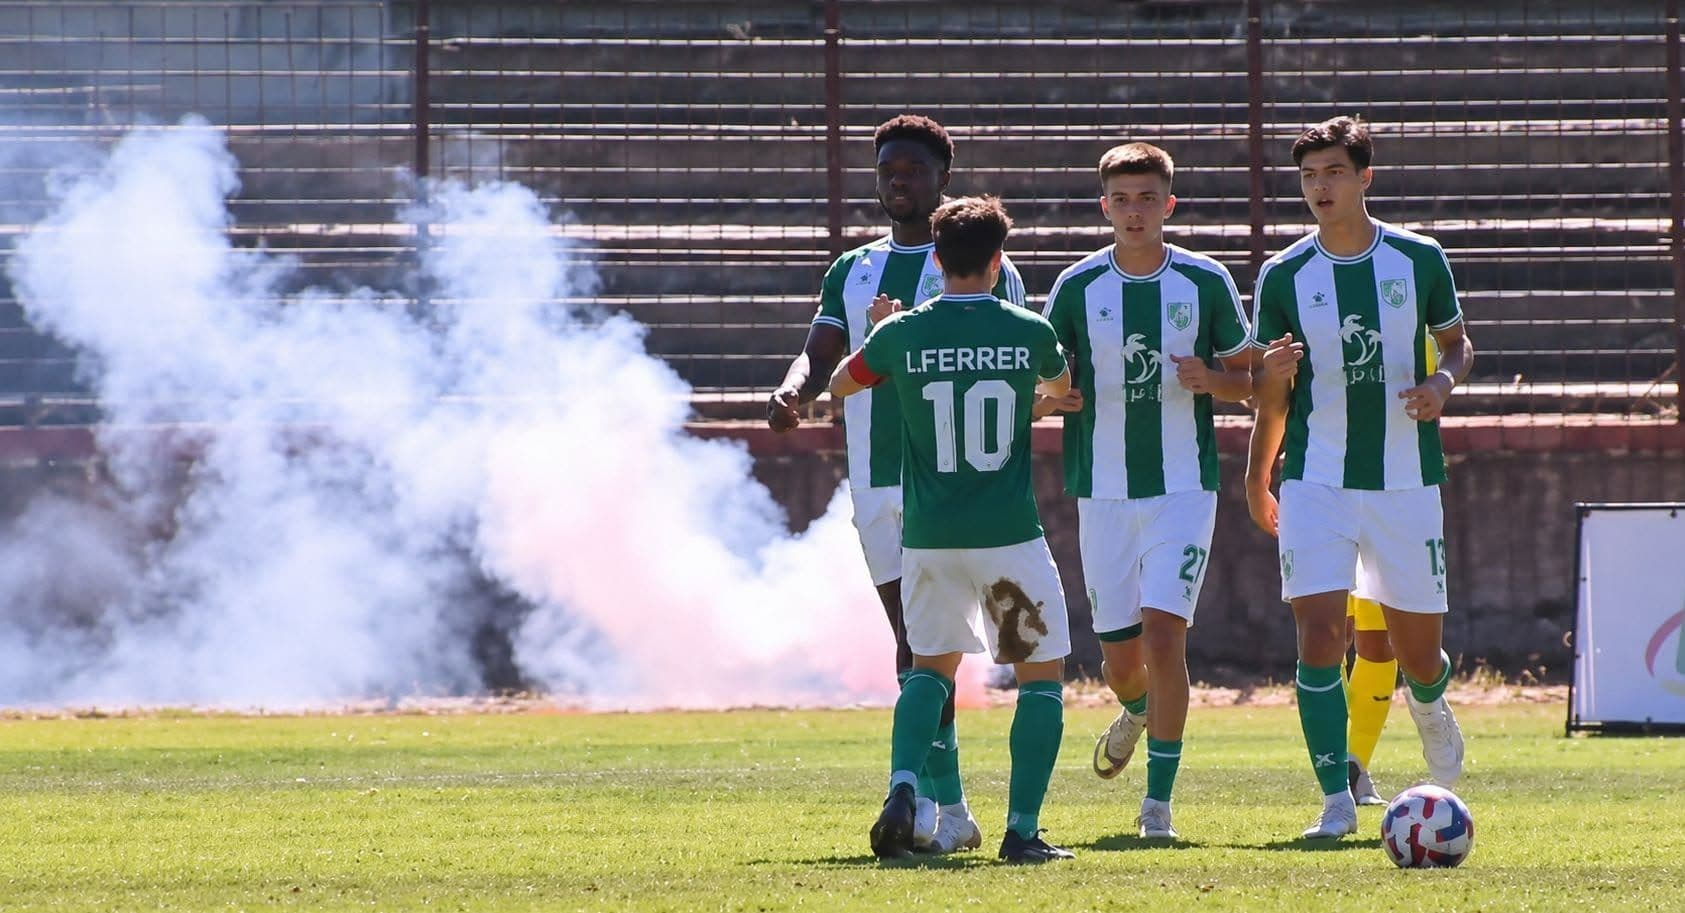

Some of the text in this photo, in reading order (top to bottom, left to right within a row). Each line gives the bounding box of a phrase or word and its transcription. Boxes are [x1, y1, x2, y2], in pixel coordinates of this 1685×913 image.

[905, 346, 1030, 373] L.FERRER
[922, 380, 1016, 473] 10
[1178, 543, 1207, 584] 27
